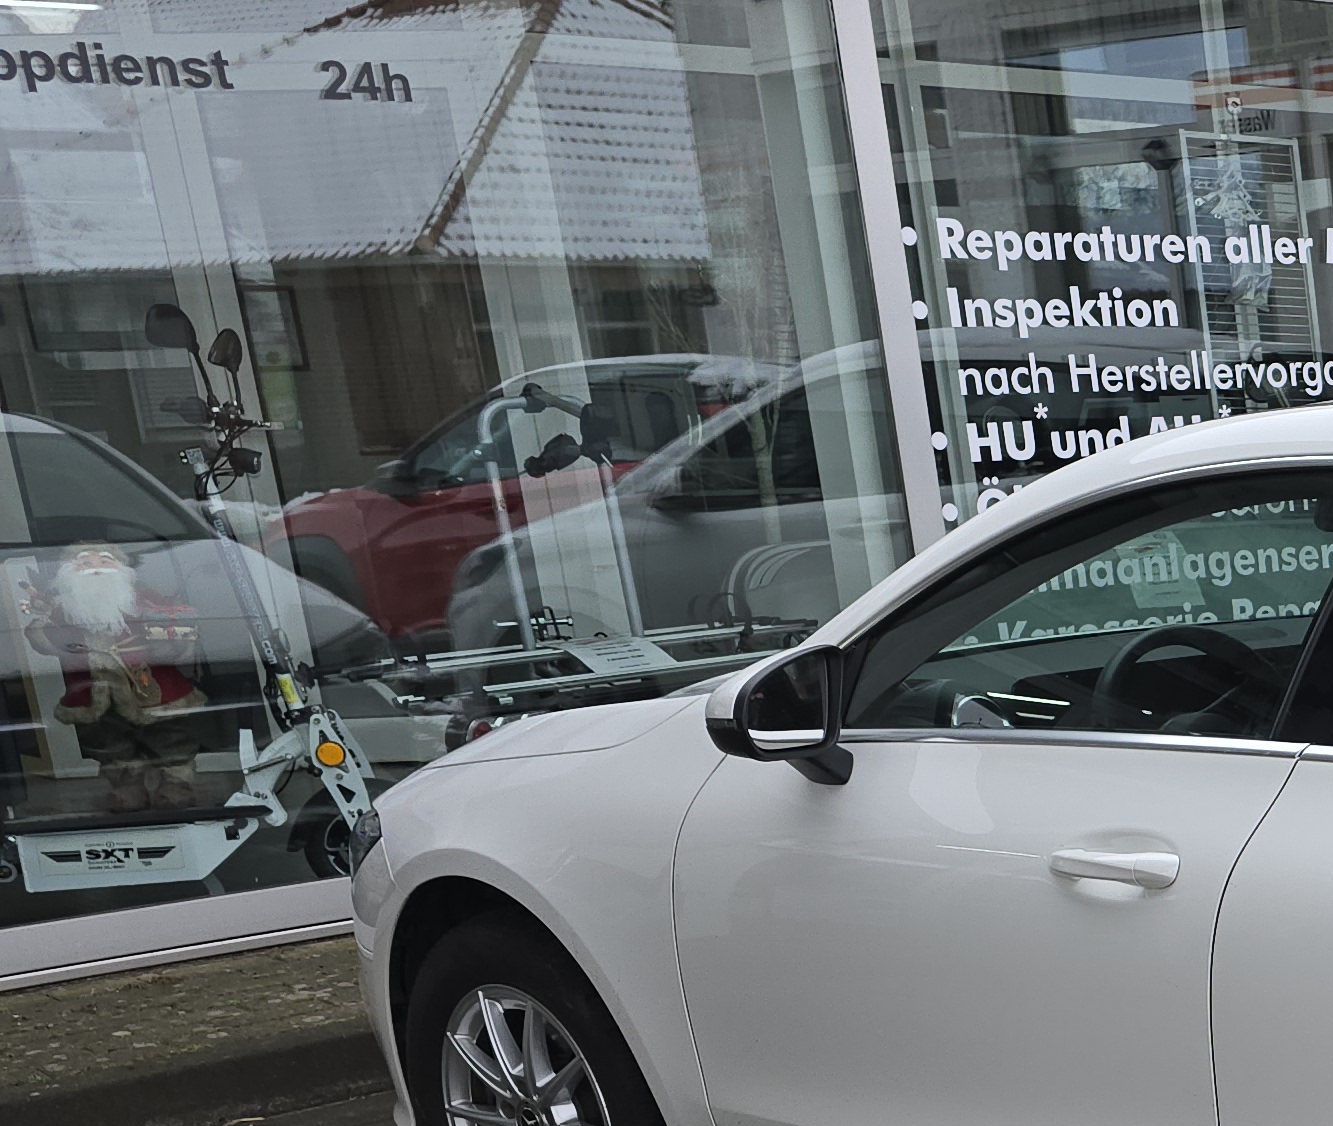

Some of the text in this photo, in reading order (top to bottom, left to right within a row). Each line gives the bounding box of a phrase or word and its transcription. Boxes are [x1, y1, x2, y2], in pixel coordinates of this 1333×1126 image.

[322, 61, 412, 102] 24h
[936, 218, 1212, 271] Reparaturen
[1225, 225, 1314, 265] aller
[946, 286, 1179, 338] Inspektion
[958, 353, 1055, 396] nach
[1050, 416, 1131, 458] und
[85, 848, 134, 864] SXT
